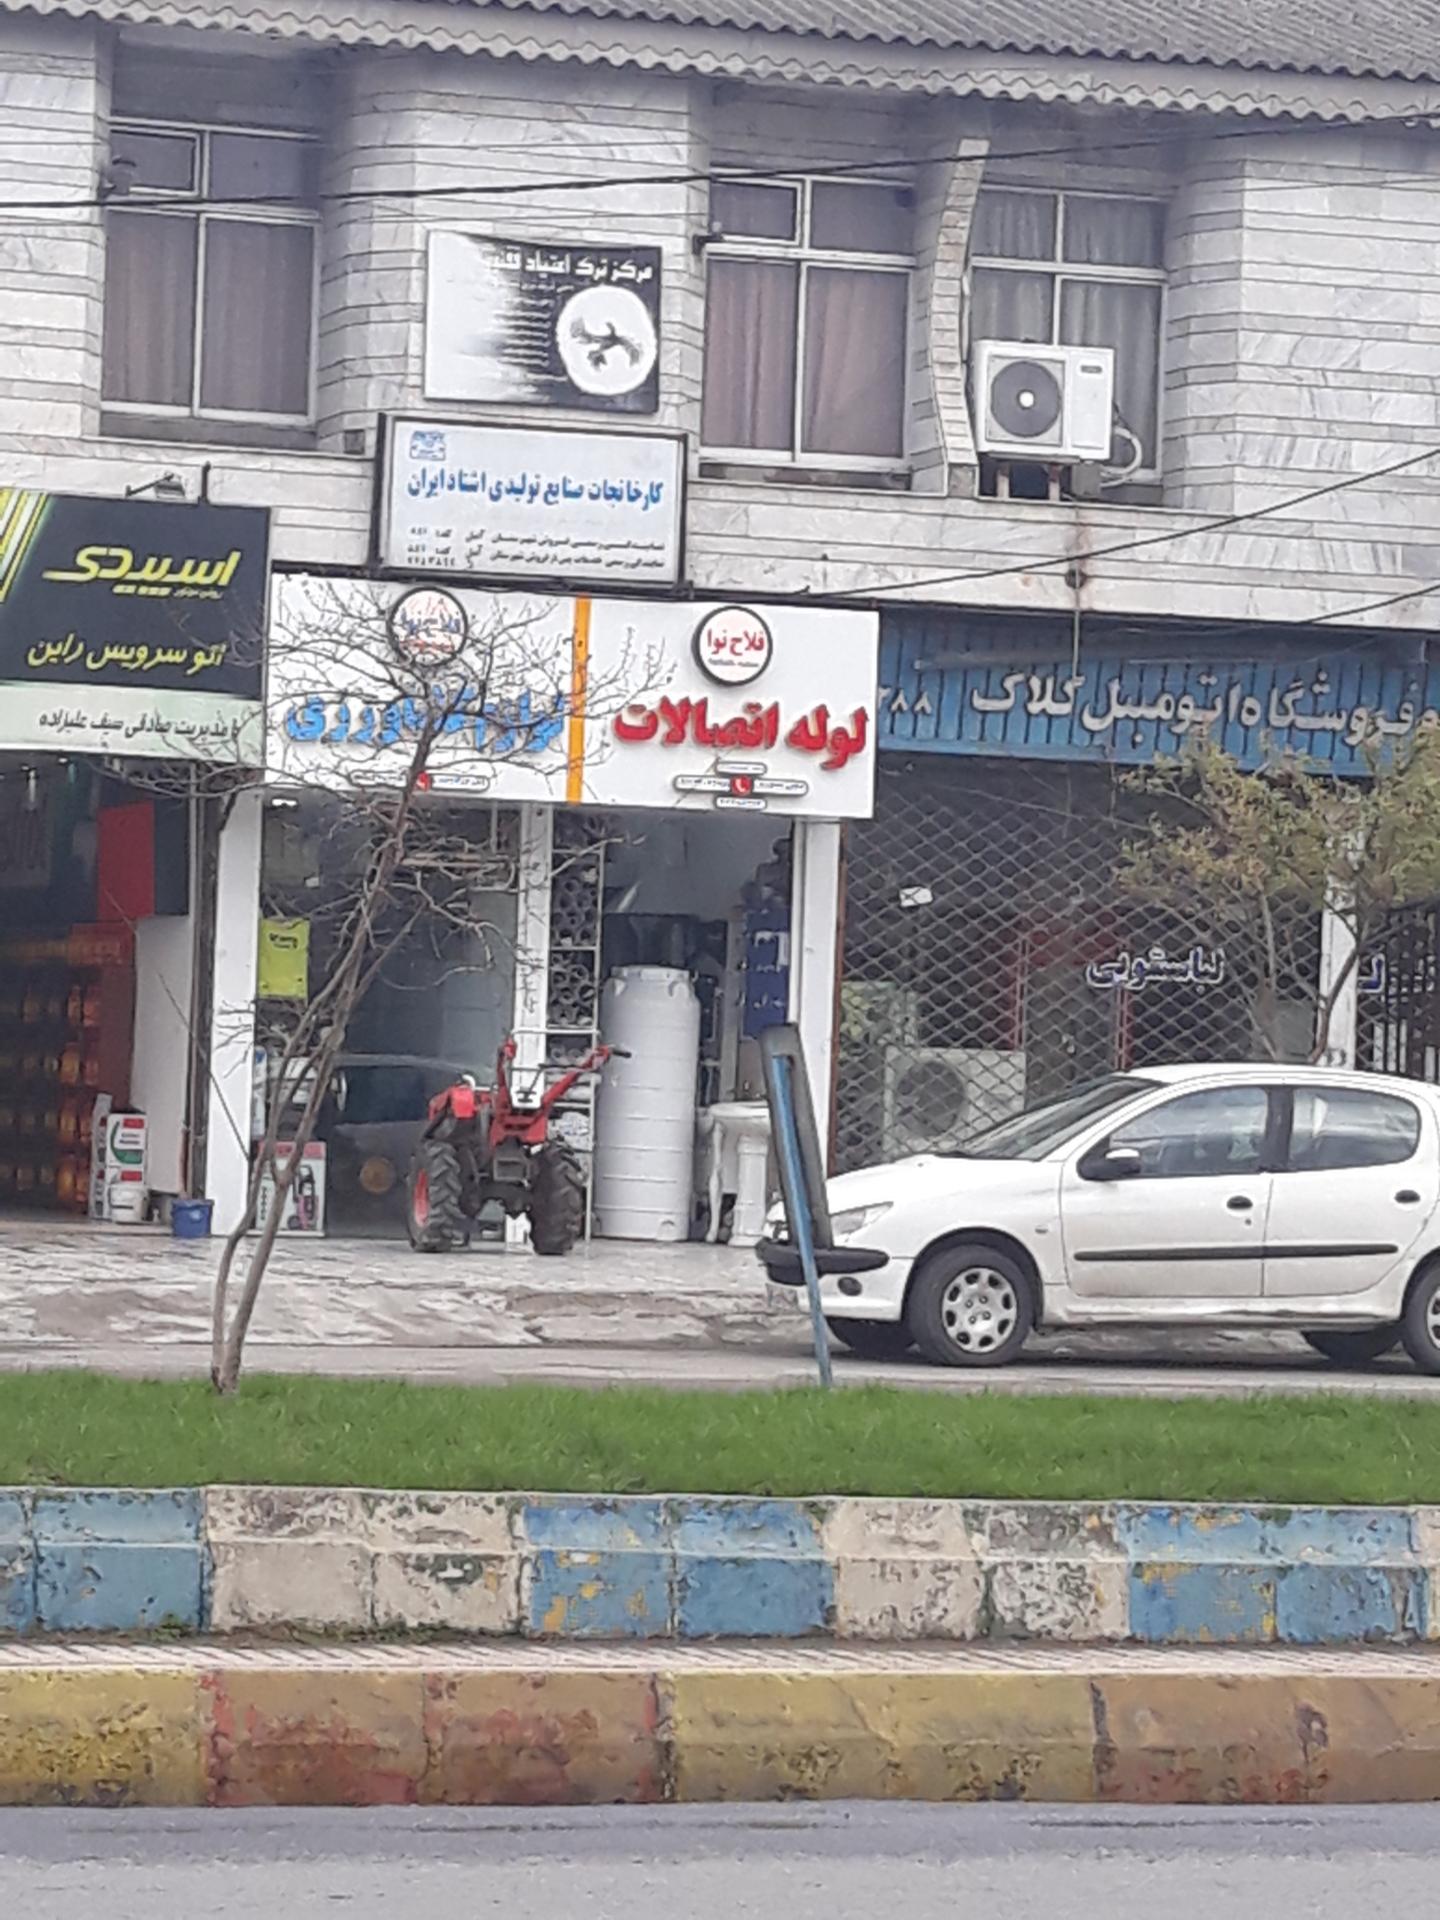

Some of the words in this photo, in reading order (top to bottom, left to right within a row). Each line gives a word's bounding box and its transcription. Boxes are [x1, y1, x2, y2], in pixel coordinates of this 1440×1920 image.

[525, 250, 571, 279] اعتیاد
[575, 256, 609, 281] ترک
[611, 259, 653, 284] مرکز
[407, 467, 446, 499] ایران
[488, 471, 541, 505] تولیدی
[543, 475, 585, 506] صنایع
[587, 478, 665, 511] کارخانجات
[27, 632, 86, 667] راین
[86, 641, 188, 671] سرویس
[706, 628, 728, 655] نوا
[729, 630, 765, 657] فلاح
[187, 641, 228, 676] اتو
[613, 695, 781, 750] اتصالات
[1081, 674, 1242, 745] اتومبیل
[1241, 671, 1416, 748] فروشگاه
[125, 712, 173, 739] صادقی
[174, 718, 229, 741] مدیریت
[785, 703, 869, 771] لوله
